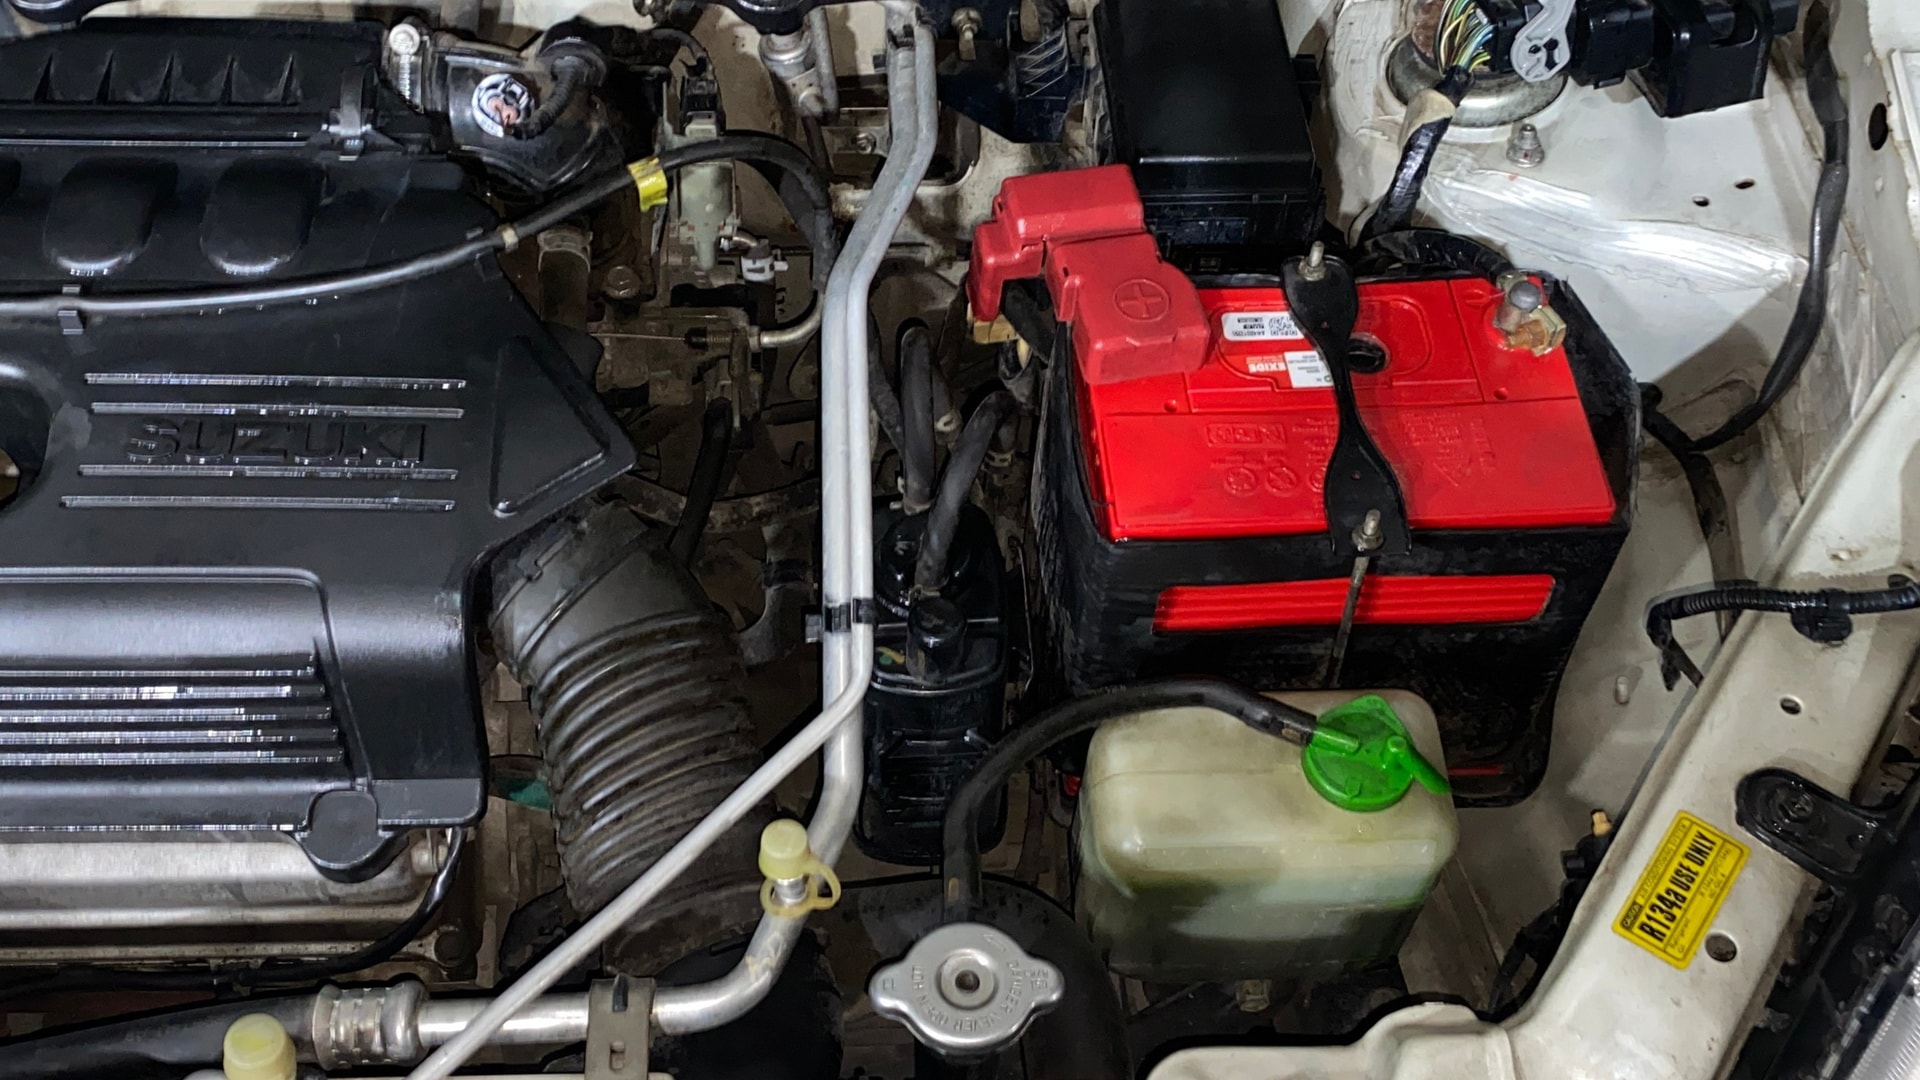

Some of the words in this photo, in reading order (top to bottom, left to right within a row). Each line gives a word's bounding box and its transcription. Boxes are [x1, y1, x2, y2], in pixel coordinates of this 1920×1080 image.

[1249, 362, 1287, 373] EXIDE
[127, 421, 426, 466] SUZUKI
[1639, 889, 1687, 942] R134a
[1669, 862, 1699, 892] USE
[1684, 831, 1717, 867] ONLY
[912, 965, 924, 989] HOT
